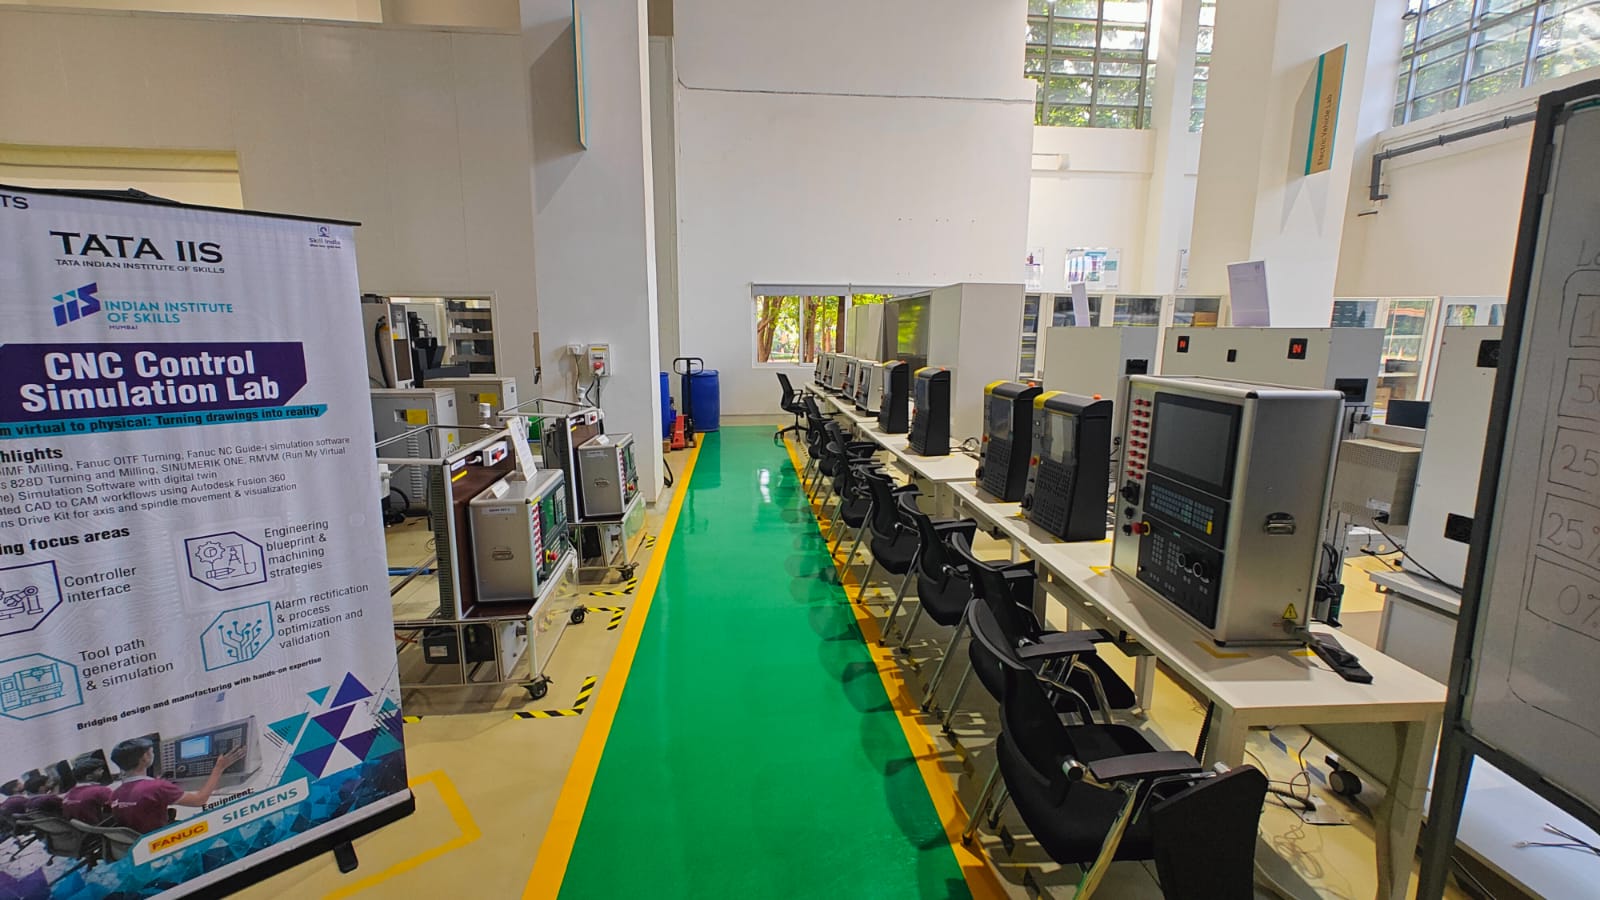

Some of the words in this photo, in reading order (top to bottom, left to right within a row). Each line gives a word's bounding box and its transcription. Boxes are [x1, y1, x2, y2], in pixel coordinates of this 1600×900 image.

[49, 230, 165, 260] TATA
[176, 240, 224, 264] IIS
[56, 259, 81, 267] TATA
[83, 261, 121, 269] INDIAN
[123, 263, 175, 272] INSTITUTE
[105, 301, 160, 312] INDIAN
[165, 302, 233, 313] INSTITUTE
[107, 313, 128, 323] OF
[135, 313, 181, 324] SKILLS
[44, 352, 124, 381] CNC
[135, 350, 255, 378] Control
[20, 379, 218, 413] Simulation
[226, 376, 280, 402] Lab
[16, 421, 66, 436] virtual
[70, 421, 86, 432] to
[90, 417, 152, 433] physical:
[156, 413, 202, 426] Turning
[206, 410, 259, 422] drawings
[261, 408, 283, 418] into
[285, 405, 320, 417] reality
[0, 447, 63, 464] hlights
[76, 459, 110, 469] Fanuc
[187, 449, 216, 458] Fanuc
[218, 446, 233, 456] NC
[270, 439, 314, 450] simulation
[316, 437, 350, 446] software
[10, 476, 43, 488] 828D
[47, 473, 92, 485] Turning
[95, 470, 116, 479] and
[161, 460, 221, 472] SINUMERIK
[249, 453, 279, 463] RMVM
[282, 451, 303, 461] (Run
[305, 449, 317, 459] My
[320, 447, 346, 456] Virtual
[18, 486, 83, 500] Simulation
[86, 480, 136, 493] Software
[139, 477, 161, 487] with
[164, 473, 194, 485] digital
[197, 471, 217, 480] twin
[25, 501, 52, 512] CAD
[55, 500, 67, 509] to
[71, 495, 98, 507] CAM
[102, 490, 157, 502] workflows
[160, 486, 188, 496] using
[191, 479, 235, 492] Autodesk
[237, 476, 267, 486] Fusion
[269, 473, 286, 483] 360
[18, 515, 50, 527] Drive
[54, 511, 70, 521] Kit
[73, 510, 89, 519] for
[93, 506, 116, 516] axis
[118, 503, 138, 512] and
[140, 498, 178, 511] spindle
[181, 491, 231, 504] movement
[234, 489, 241, 498] &
[243, 483, 297, 496] visualization
[29, 534, 80, 550] focus
[84, 527, 131, 543] areas
[264, 520, 329, 539] Engineering
[266, 534, 316, 552] blueprint
[319, 533, 327, 543] &
[268, 547, 325, 565] machining
[64, 567, 137, 588] Controller
[270, 561, 323, 578] strategies
[67, 582, 131, 603] interface
[274, 597, 307, 611] Alarm
[310, 583, 369, 602] rectification
[277, 614, 285, 624] &
[289, 605, 331, 622] process
[278, 614, 342, 637] optimization
[345, 608, 363, 620] and
[79, 646, 110, 662] Tool
[115, 637, 145, 656] path
[280, 630, 330, 649] validation
[82, 652, 157, 678] generation
[86, 680, 97, 691] &
[102, 662, 174, 688] simulation
[77, 714, 118, 730] Bridging
[120, 704, 151, 718] design
[153, 699, 170, 709] and
[171, 682, 232, 704] manufacturing
[234, 676, 251, 686] with
[253, 667, 287, 680] hands-on
[289, 657, 322, 671] expertise
[201, 788, 254, 812] Equipment:
[151, 825, 205, 850] FANUC
[222, 787, 298, 824] SIEMENS
